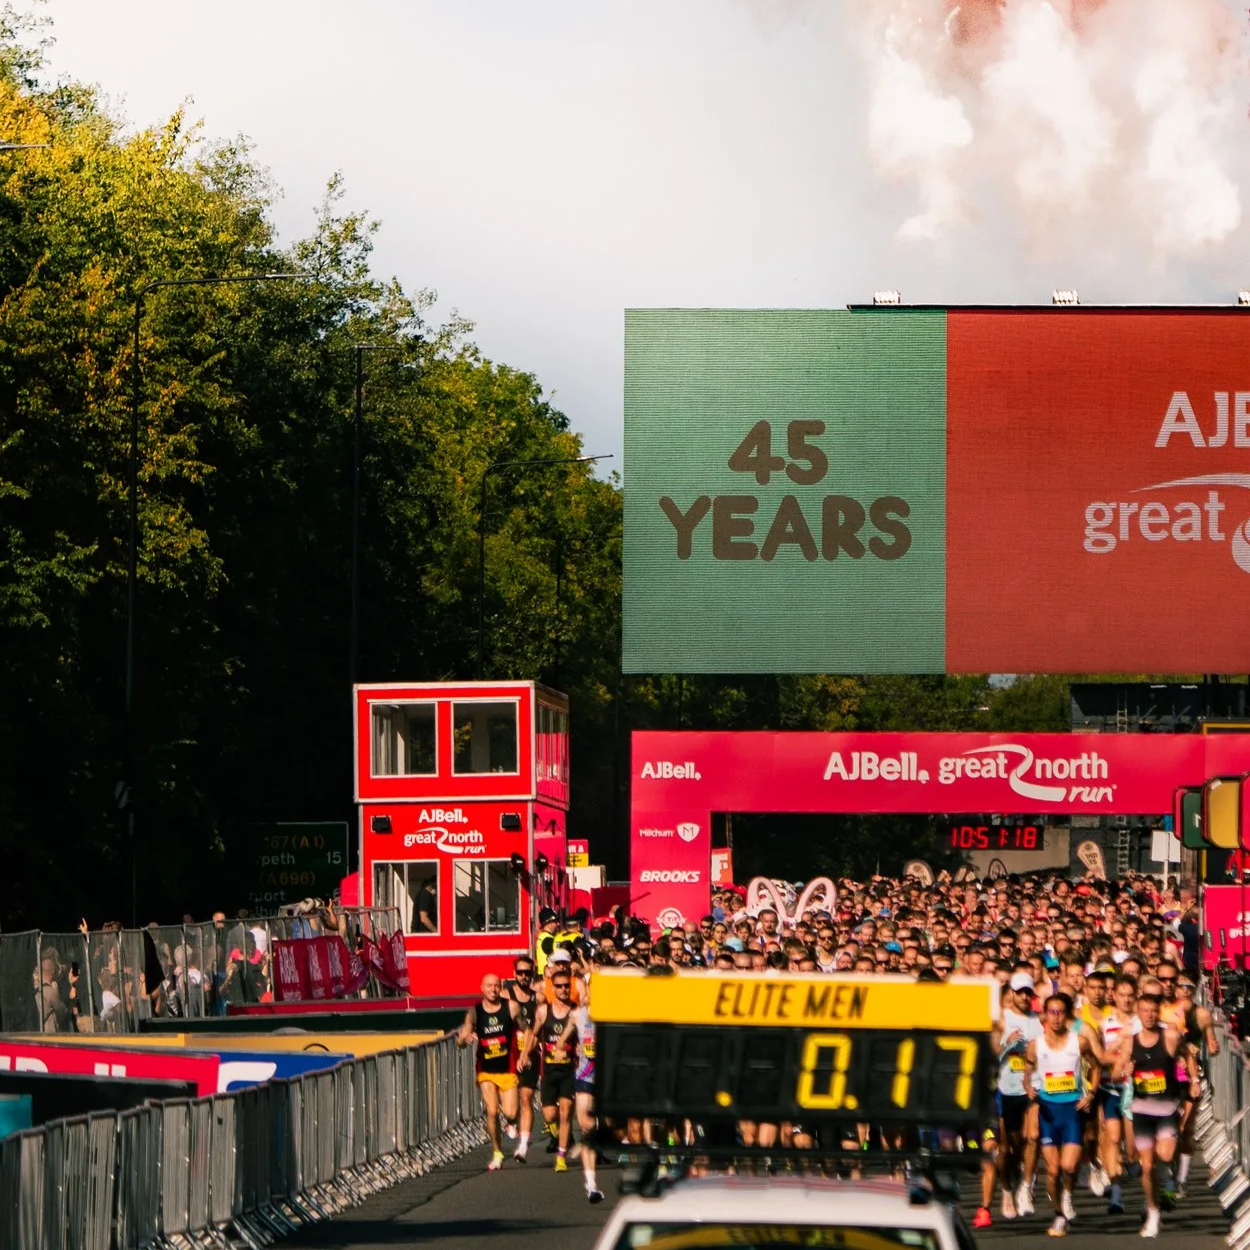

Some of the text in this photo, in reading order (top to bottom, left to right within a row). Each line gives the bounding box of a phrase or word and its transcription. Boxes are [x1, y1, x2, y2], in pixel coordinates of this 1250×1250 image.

[727, 420, 829, 486] 45
[659, 495, 912, 561] YEARS
[1083, 489, 1225, 554] great
[938, 752, 1008, 784] great
[1035, 752, 1108, 779] north
[1068, 785, 1114, 803] run
[403, 830, 483, 847] great north
[326, 851, 342, 865] 15
[464, 845, 486, 854] run
[640, 870, 701, 883] BROOKS
[713, 982, 869, 1020] ELITE MEN
[484, 1025, 505, 1035] ARMY
